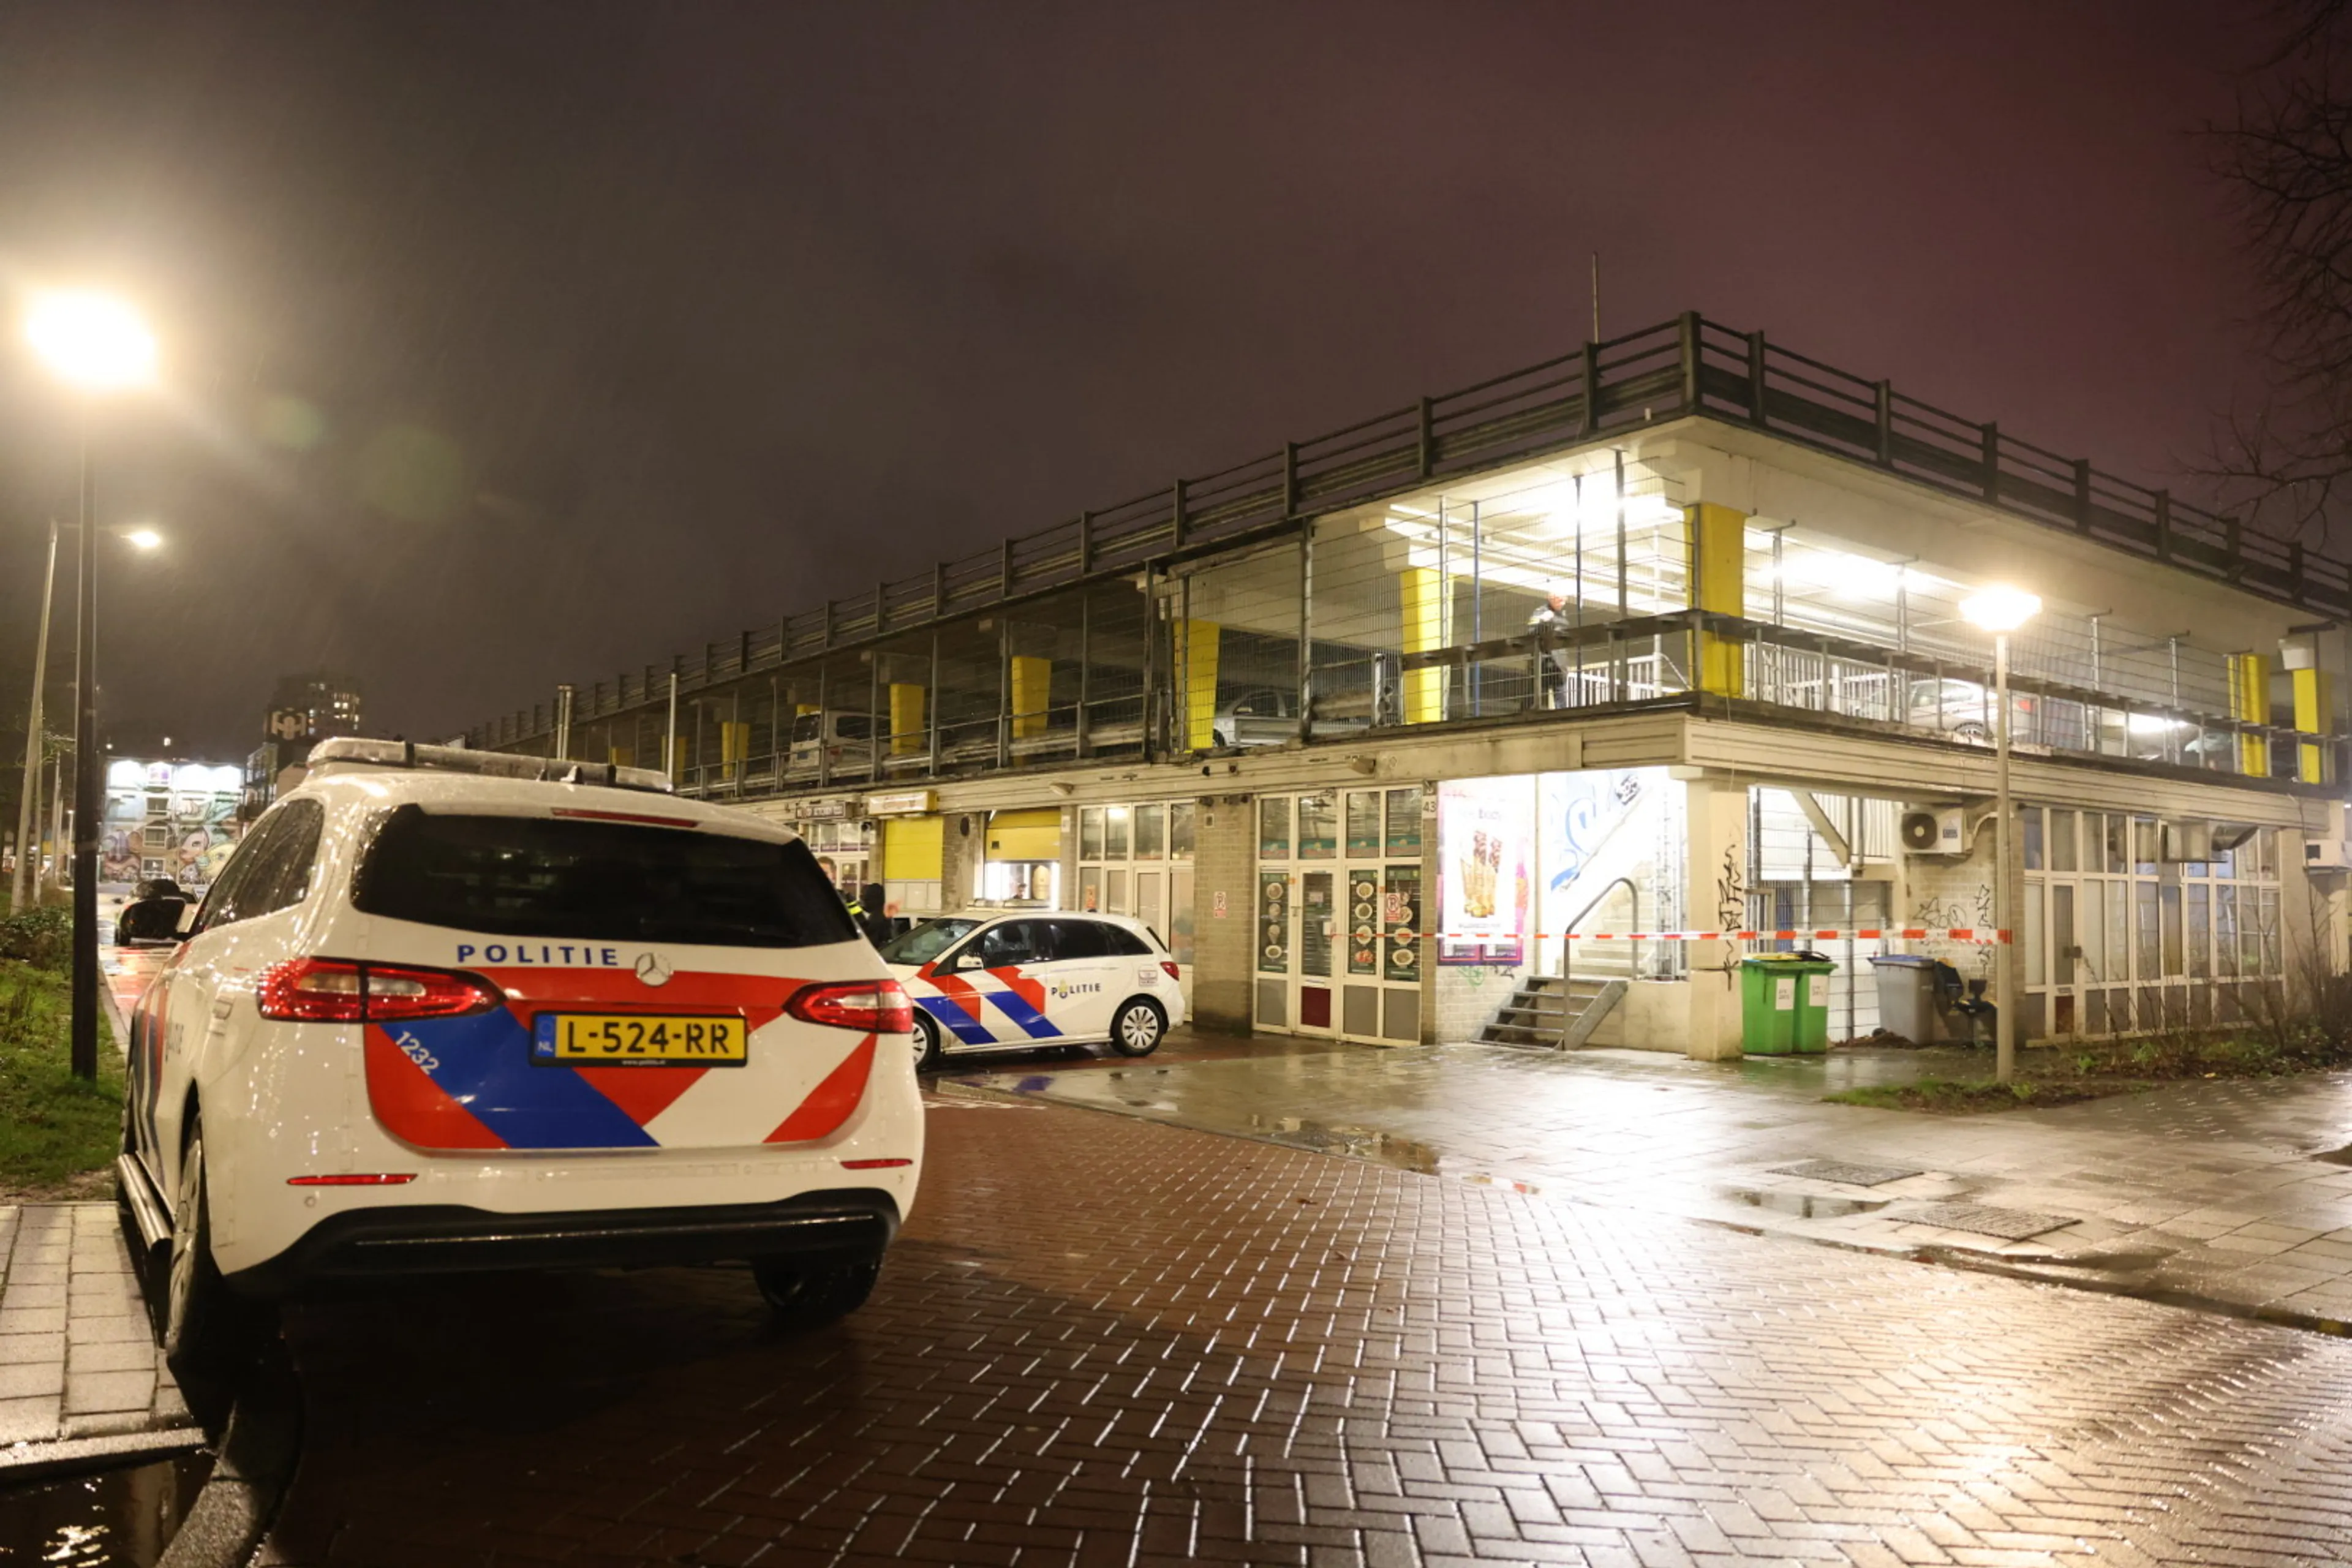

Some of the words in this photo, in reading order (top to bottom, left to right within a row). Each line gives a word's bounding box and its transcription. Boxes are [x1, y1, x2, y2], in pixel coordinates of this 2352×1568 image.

[1423, 801, 1436, 813] 43
[456, 944, 618, 966] POLITIE
[1051, 982, 1101, 998] POLITIE
[538, 1041, 554, 1052] NL
[567, 1021, 729, 1054] L-524-RR
[396, 1031, 439, 1076] 1232
